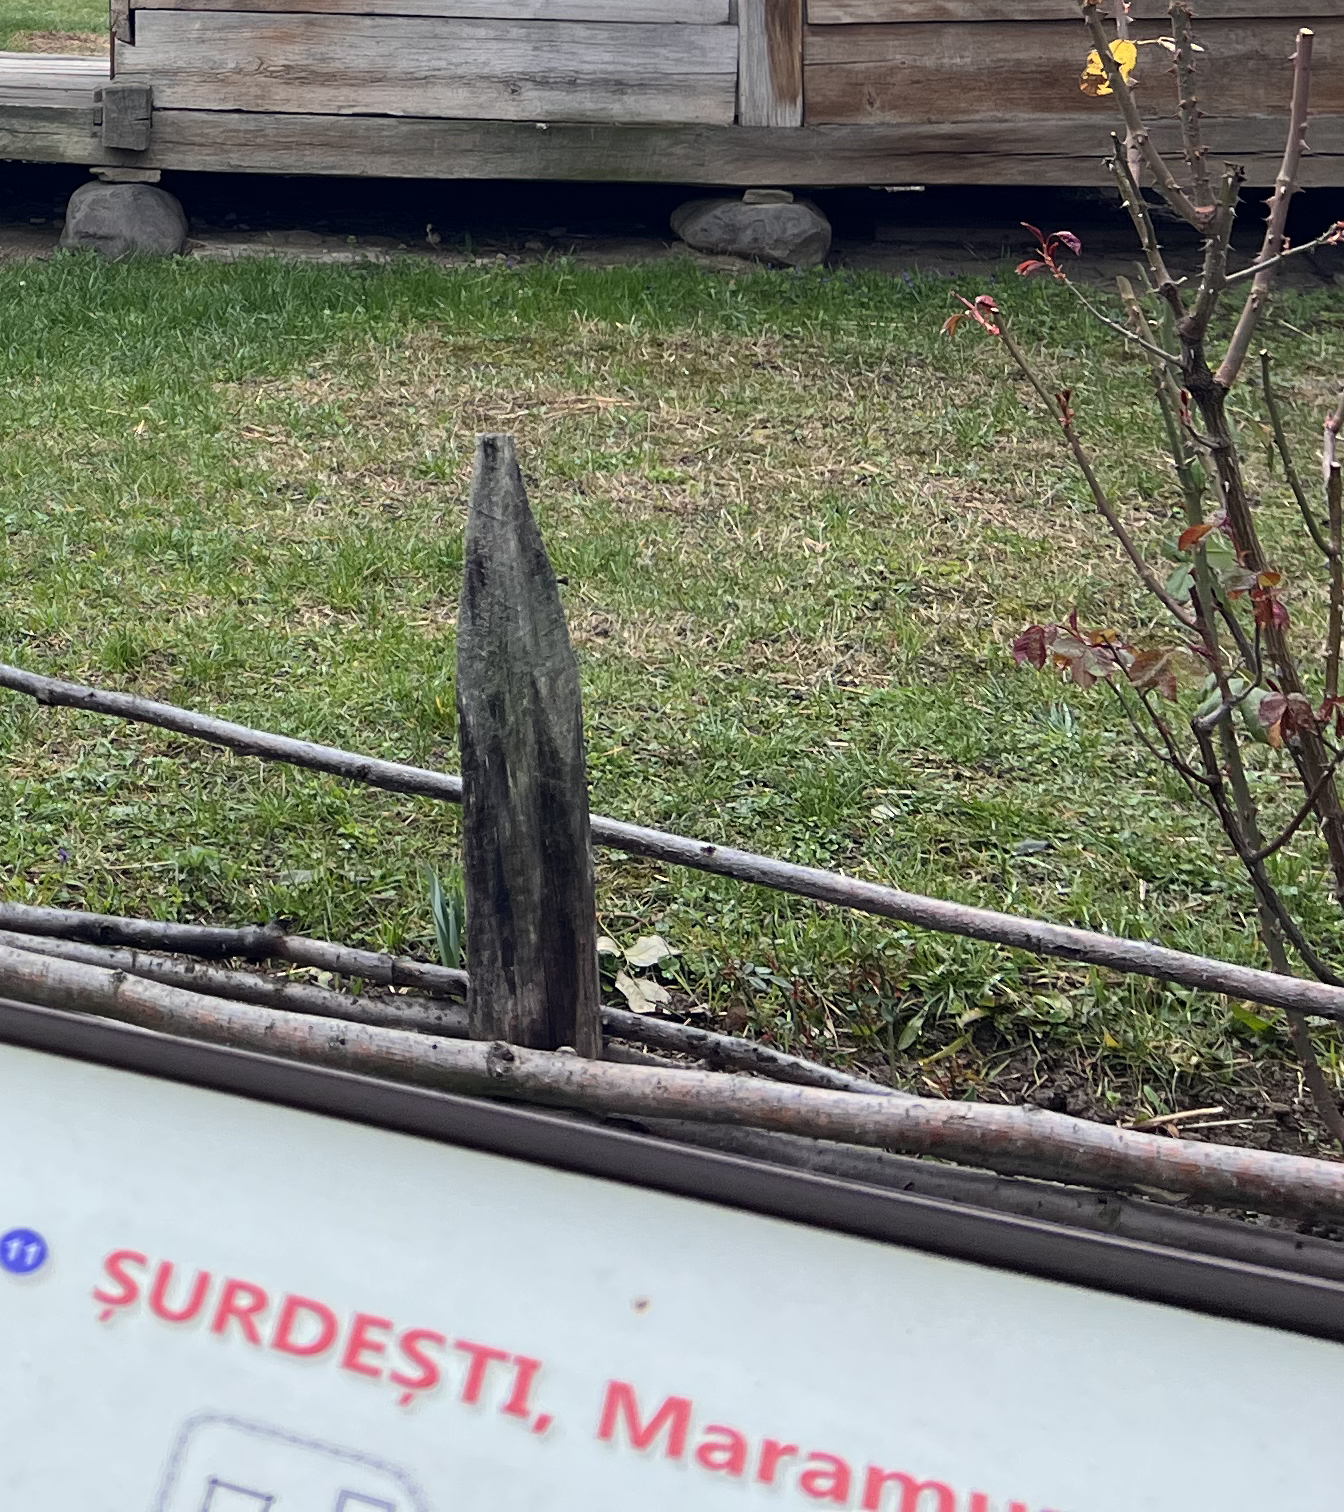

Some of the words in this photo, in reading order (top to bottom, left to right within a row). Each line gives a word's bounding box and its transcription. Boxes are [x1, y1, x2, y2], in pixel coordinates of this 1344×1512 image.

[4, 1238, 39, 1266] 11
[94, 1249, 553, 1435] ȘURDEȘTI,
[599, 1378, 1062, 1512] Maram
